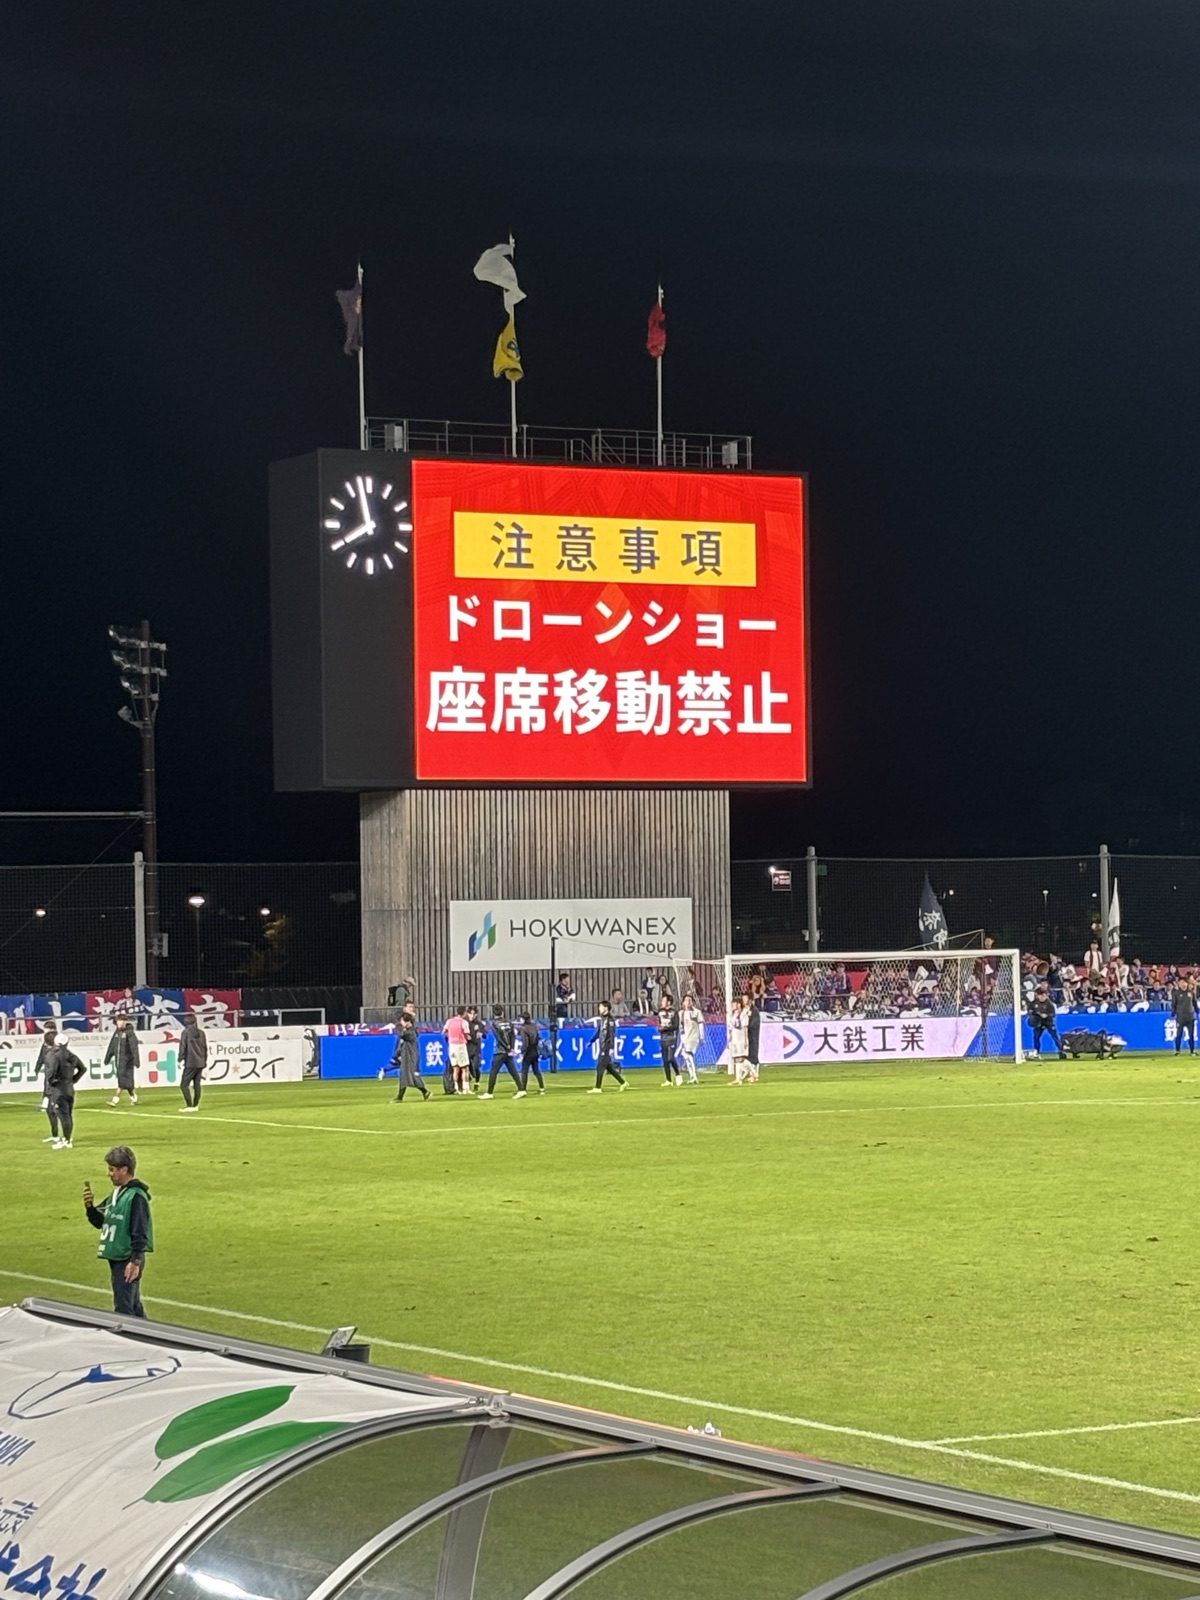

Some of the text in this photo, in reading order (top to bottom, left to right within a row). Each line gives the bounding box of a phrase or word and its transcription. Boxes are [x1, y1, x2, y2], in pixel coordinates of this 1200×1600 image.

[490, 520, 723, 577] 注意事項
[448, 594, 777, 650] ドローンショー
[425, 665, 792, 737] 座席移動禁止
[509, 916, 677, 938] HOKUWANEX
[622, 938, 678, 959] Group
[216, 1044, 261, 1055] Produce
[813, 1023, 925, 1055] 大鉄工業
